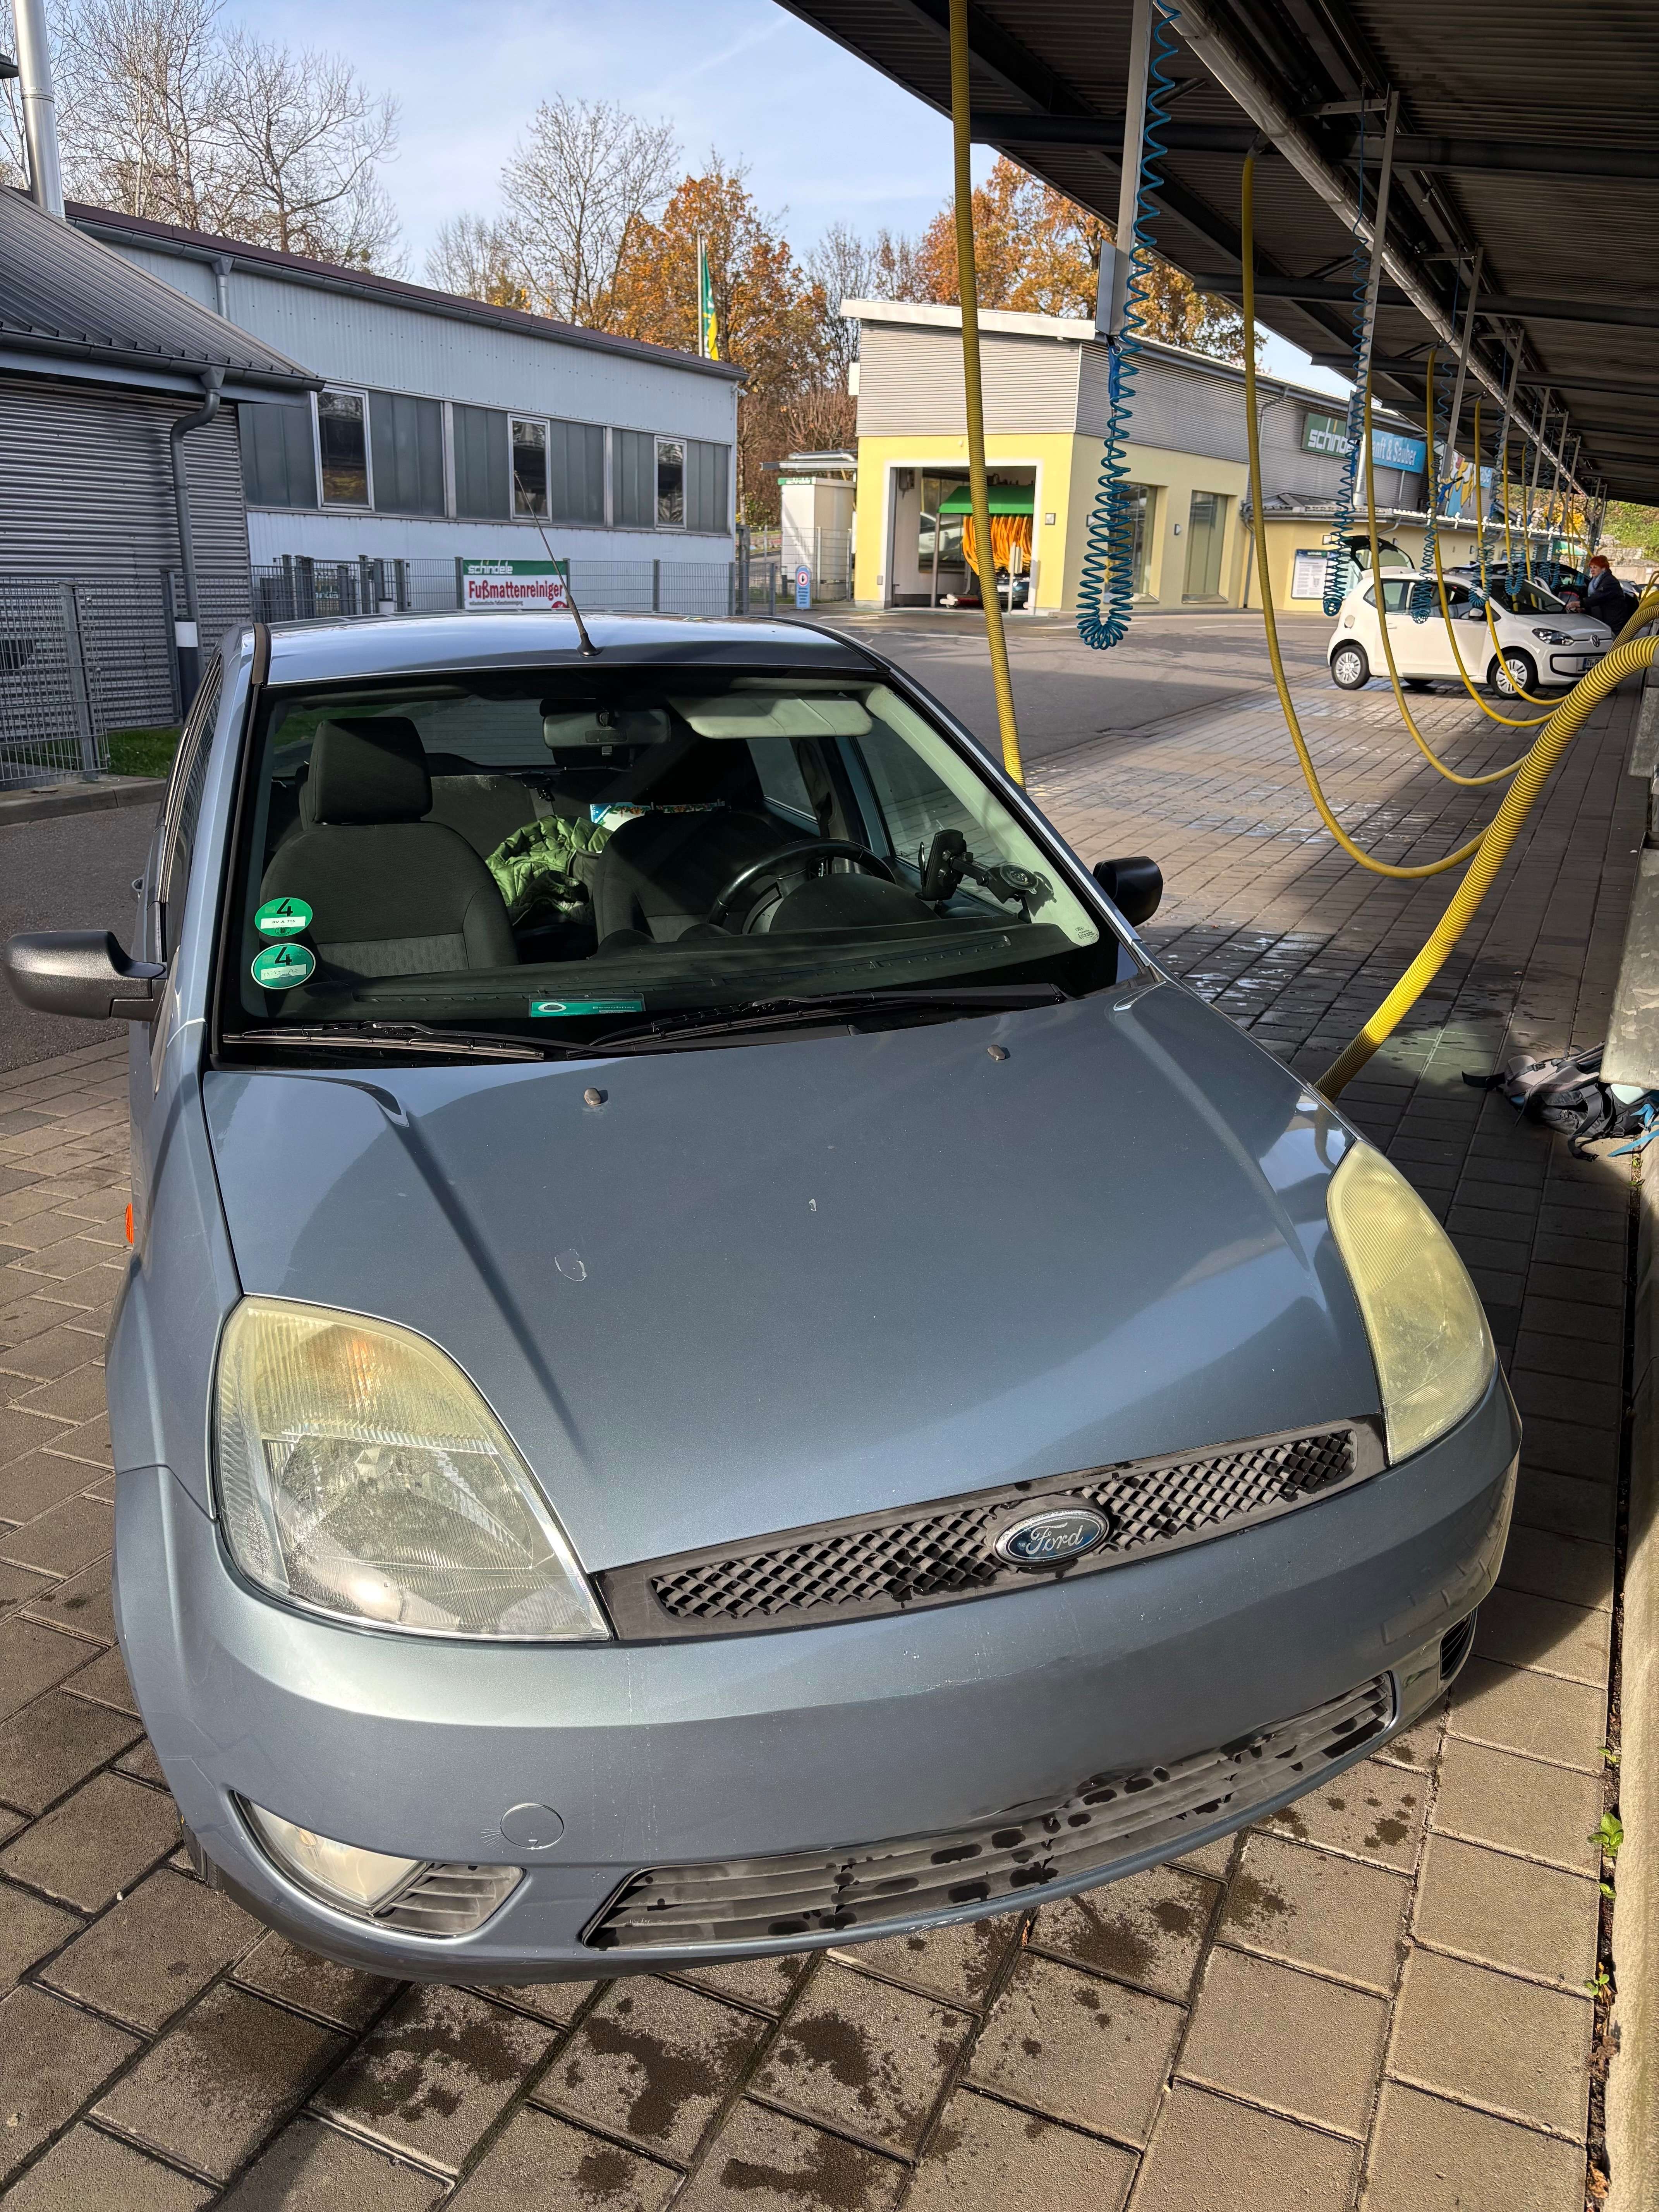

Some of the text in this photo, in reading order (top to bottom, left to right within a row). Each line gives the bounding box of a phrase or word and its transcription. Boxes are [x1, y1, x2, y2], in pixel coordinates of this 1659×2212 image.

[468, 560, 513, 574] schindele
[469, 580, 563, 601] Fußmattenreiniger
[276, 898, 293, 917] 4
[275, 946, 292, 965] 4
[1026, 1522, 1083, 1555] Ford
